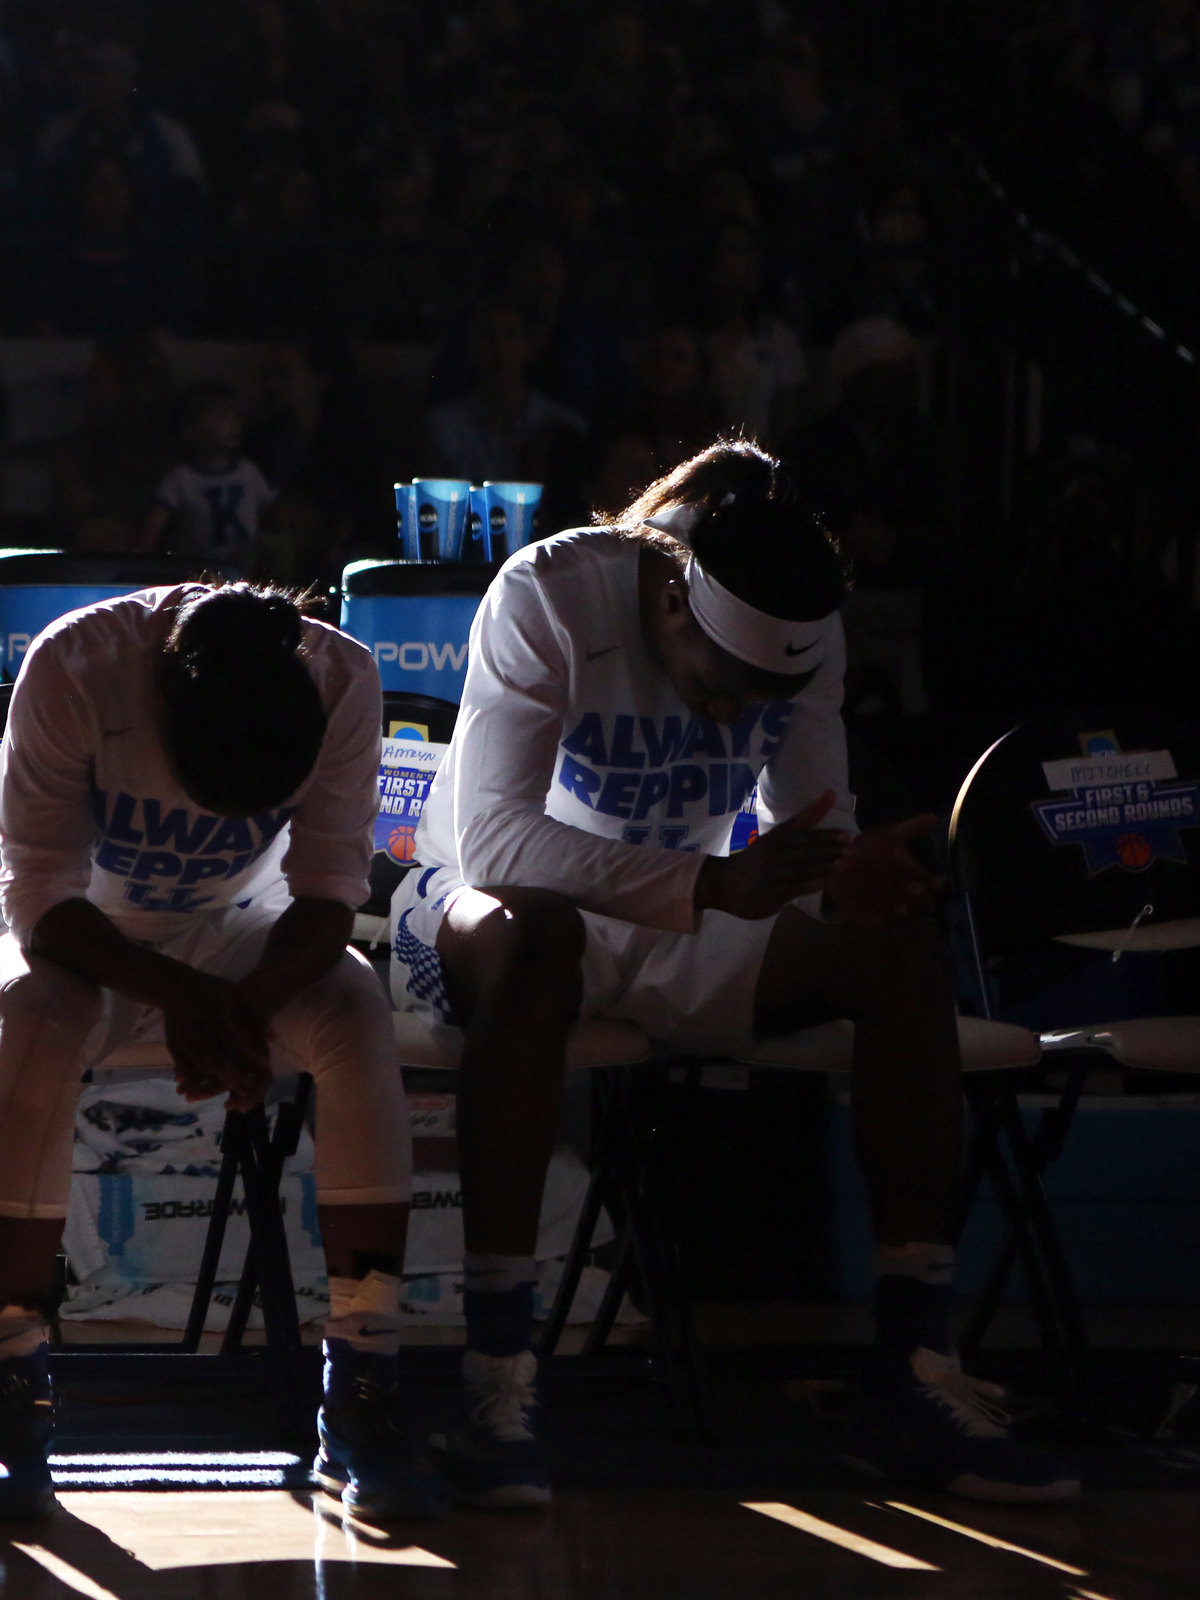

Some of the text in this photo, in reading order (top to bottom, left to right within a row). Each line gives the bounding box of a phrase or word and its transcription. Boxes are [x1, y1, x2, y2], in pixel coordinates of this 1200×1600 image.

[384, 769, 434, 781] WOMEN'S
[1085, 783, 1149, 809] FIRST &
[1054, 796, 1195, 832] SECOND ROUNDS
